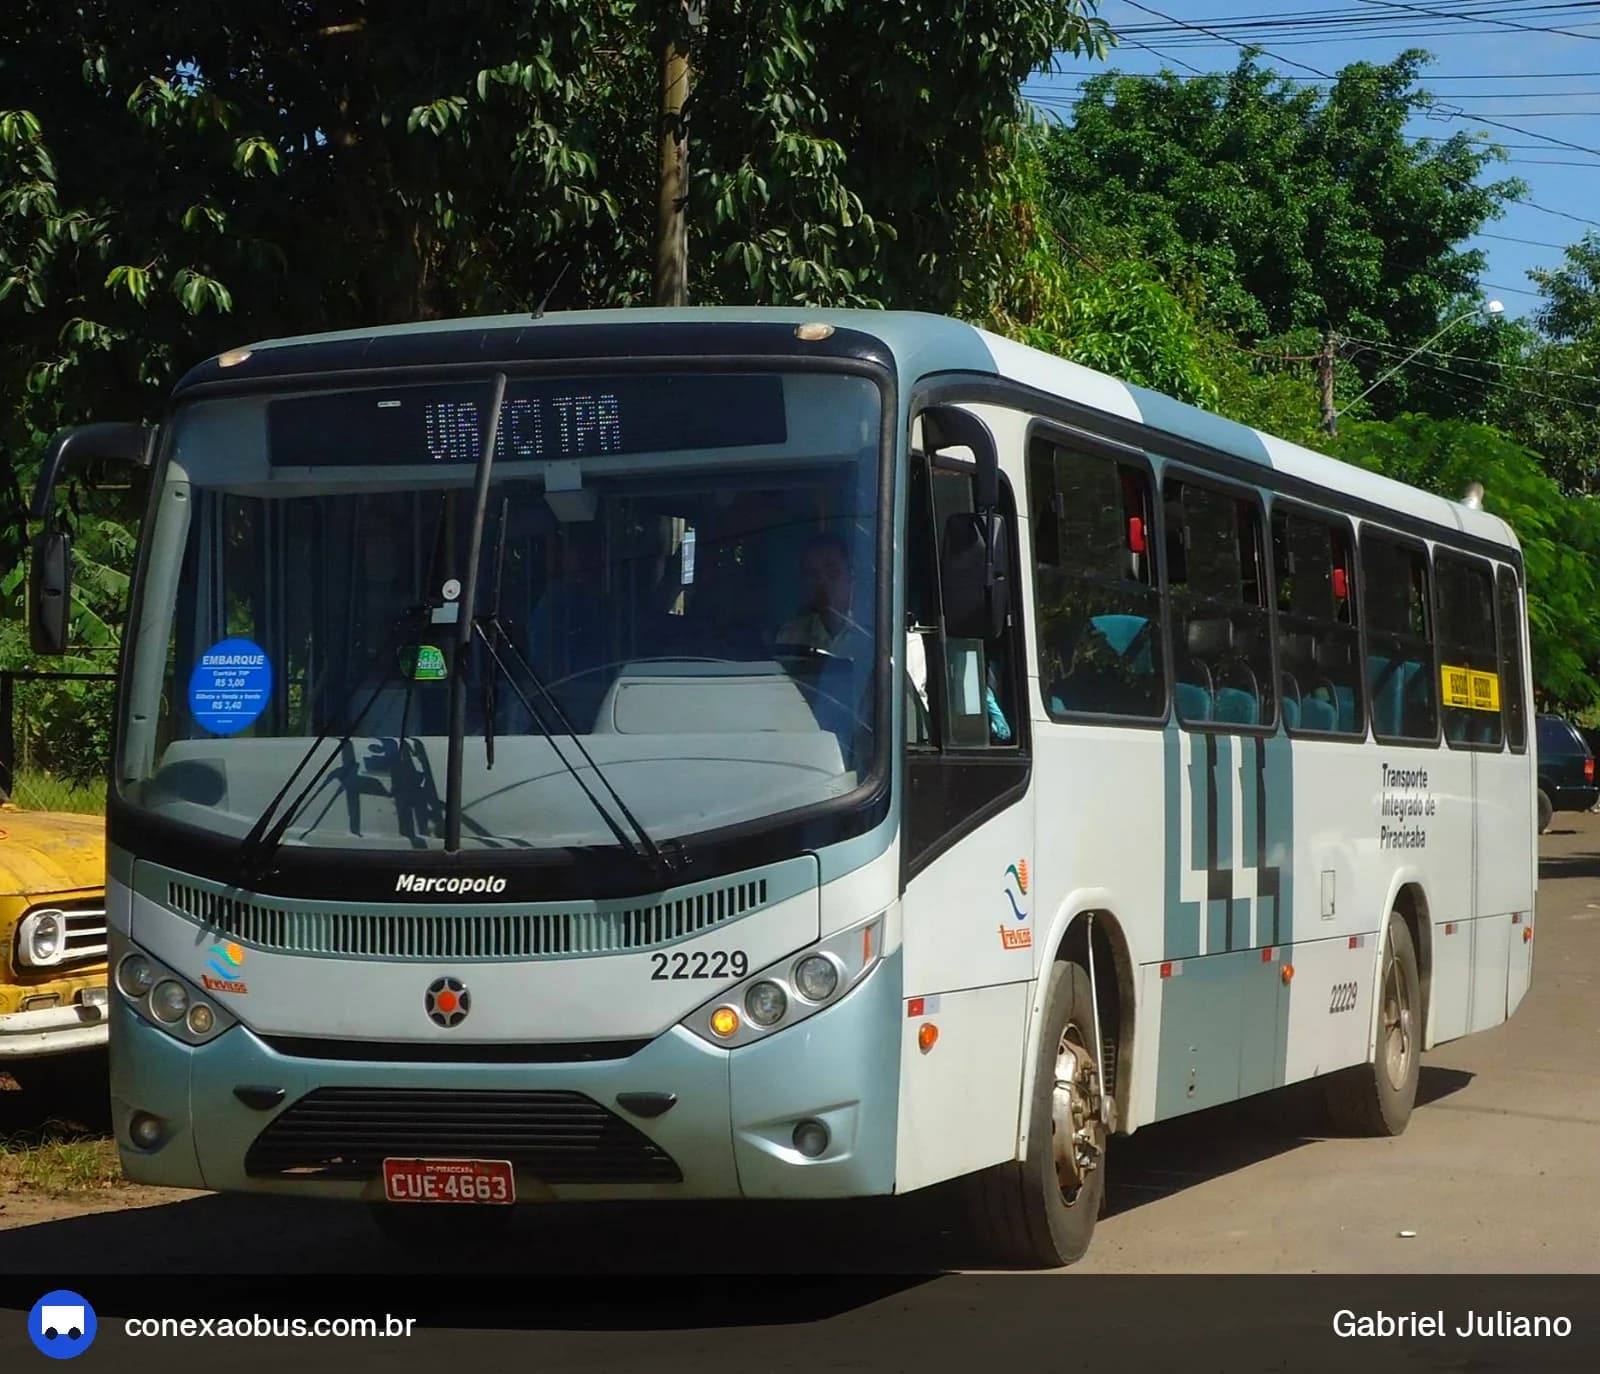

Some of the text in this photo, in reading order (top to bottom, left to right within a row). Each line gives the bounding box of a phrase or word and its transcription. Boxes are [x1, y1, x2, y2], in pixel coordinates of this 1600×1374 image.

[552, 395, 621, 452] TPA
[202, 655, 264, 665] EMBARQUE
[215, 679, 245, 688] R$ 3,00
[1382, 763, 1428, 794] Transporte
[1382, 791, 1435, 822] Integrado de
[1380, 825, 1426, 849] Piracicaba
[395, 874, 507, 894] Marcopolo
[650, 950, 748, 980] 22229
[1329, 981, 1357, 1014] 22229
